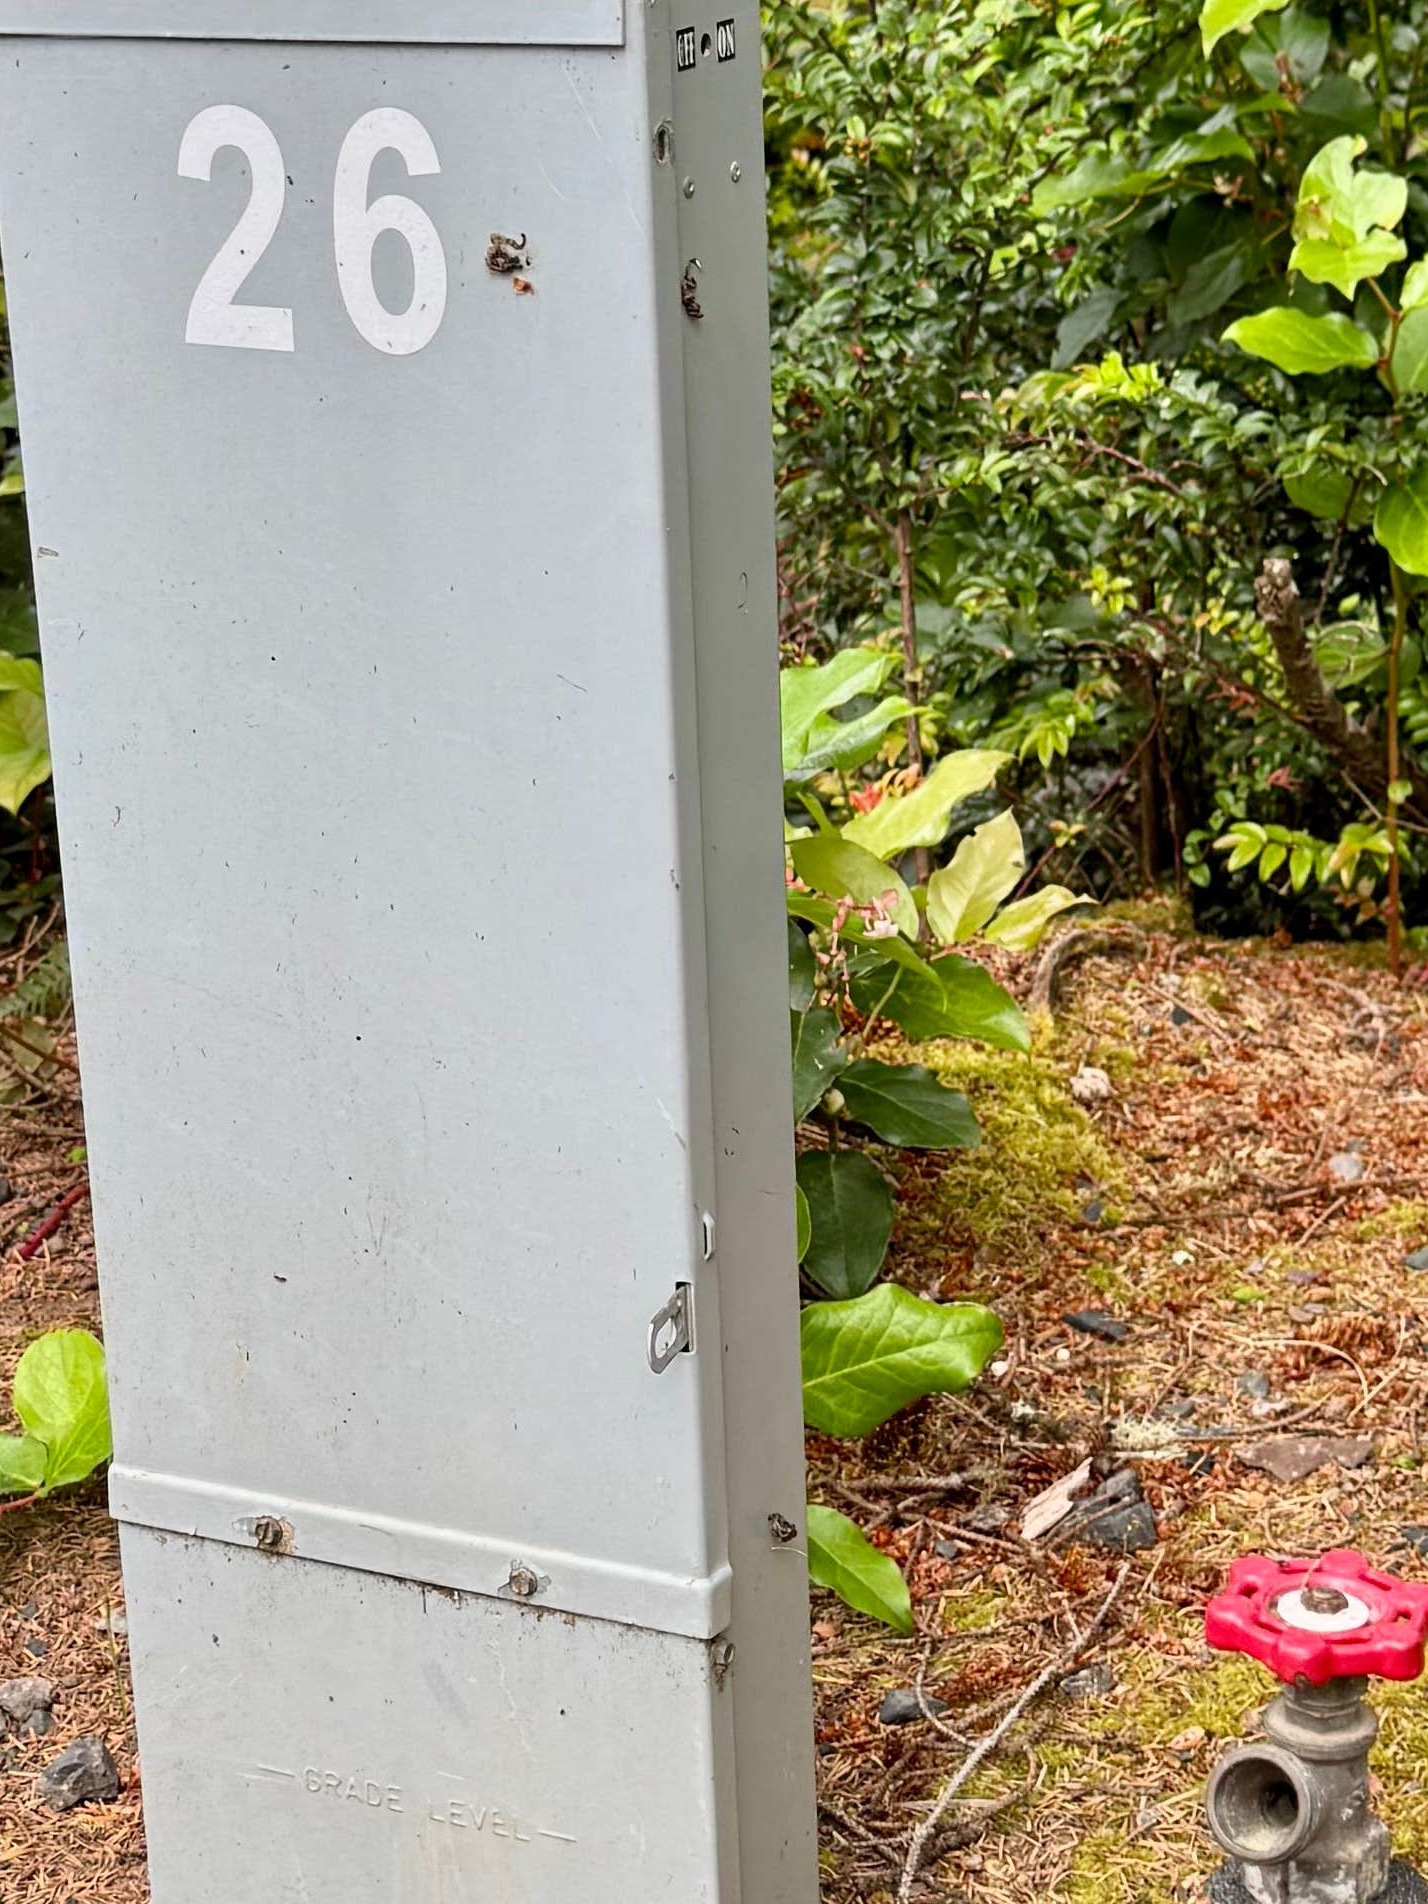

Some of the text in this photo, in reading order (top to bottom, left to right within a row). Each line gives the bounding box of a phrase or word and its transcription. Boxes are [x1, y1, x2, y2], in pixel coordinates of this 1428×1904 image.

[717, 24, 734, 58] ON
[176, 103, 448, 356] 26
[303, 1766, 531, 1843] GRADE LEVEL
